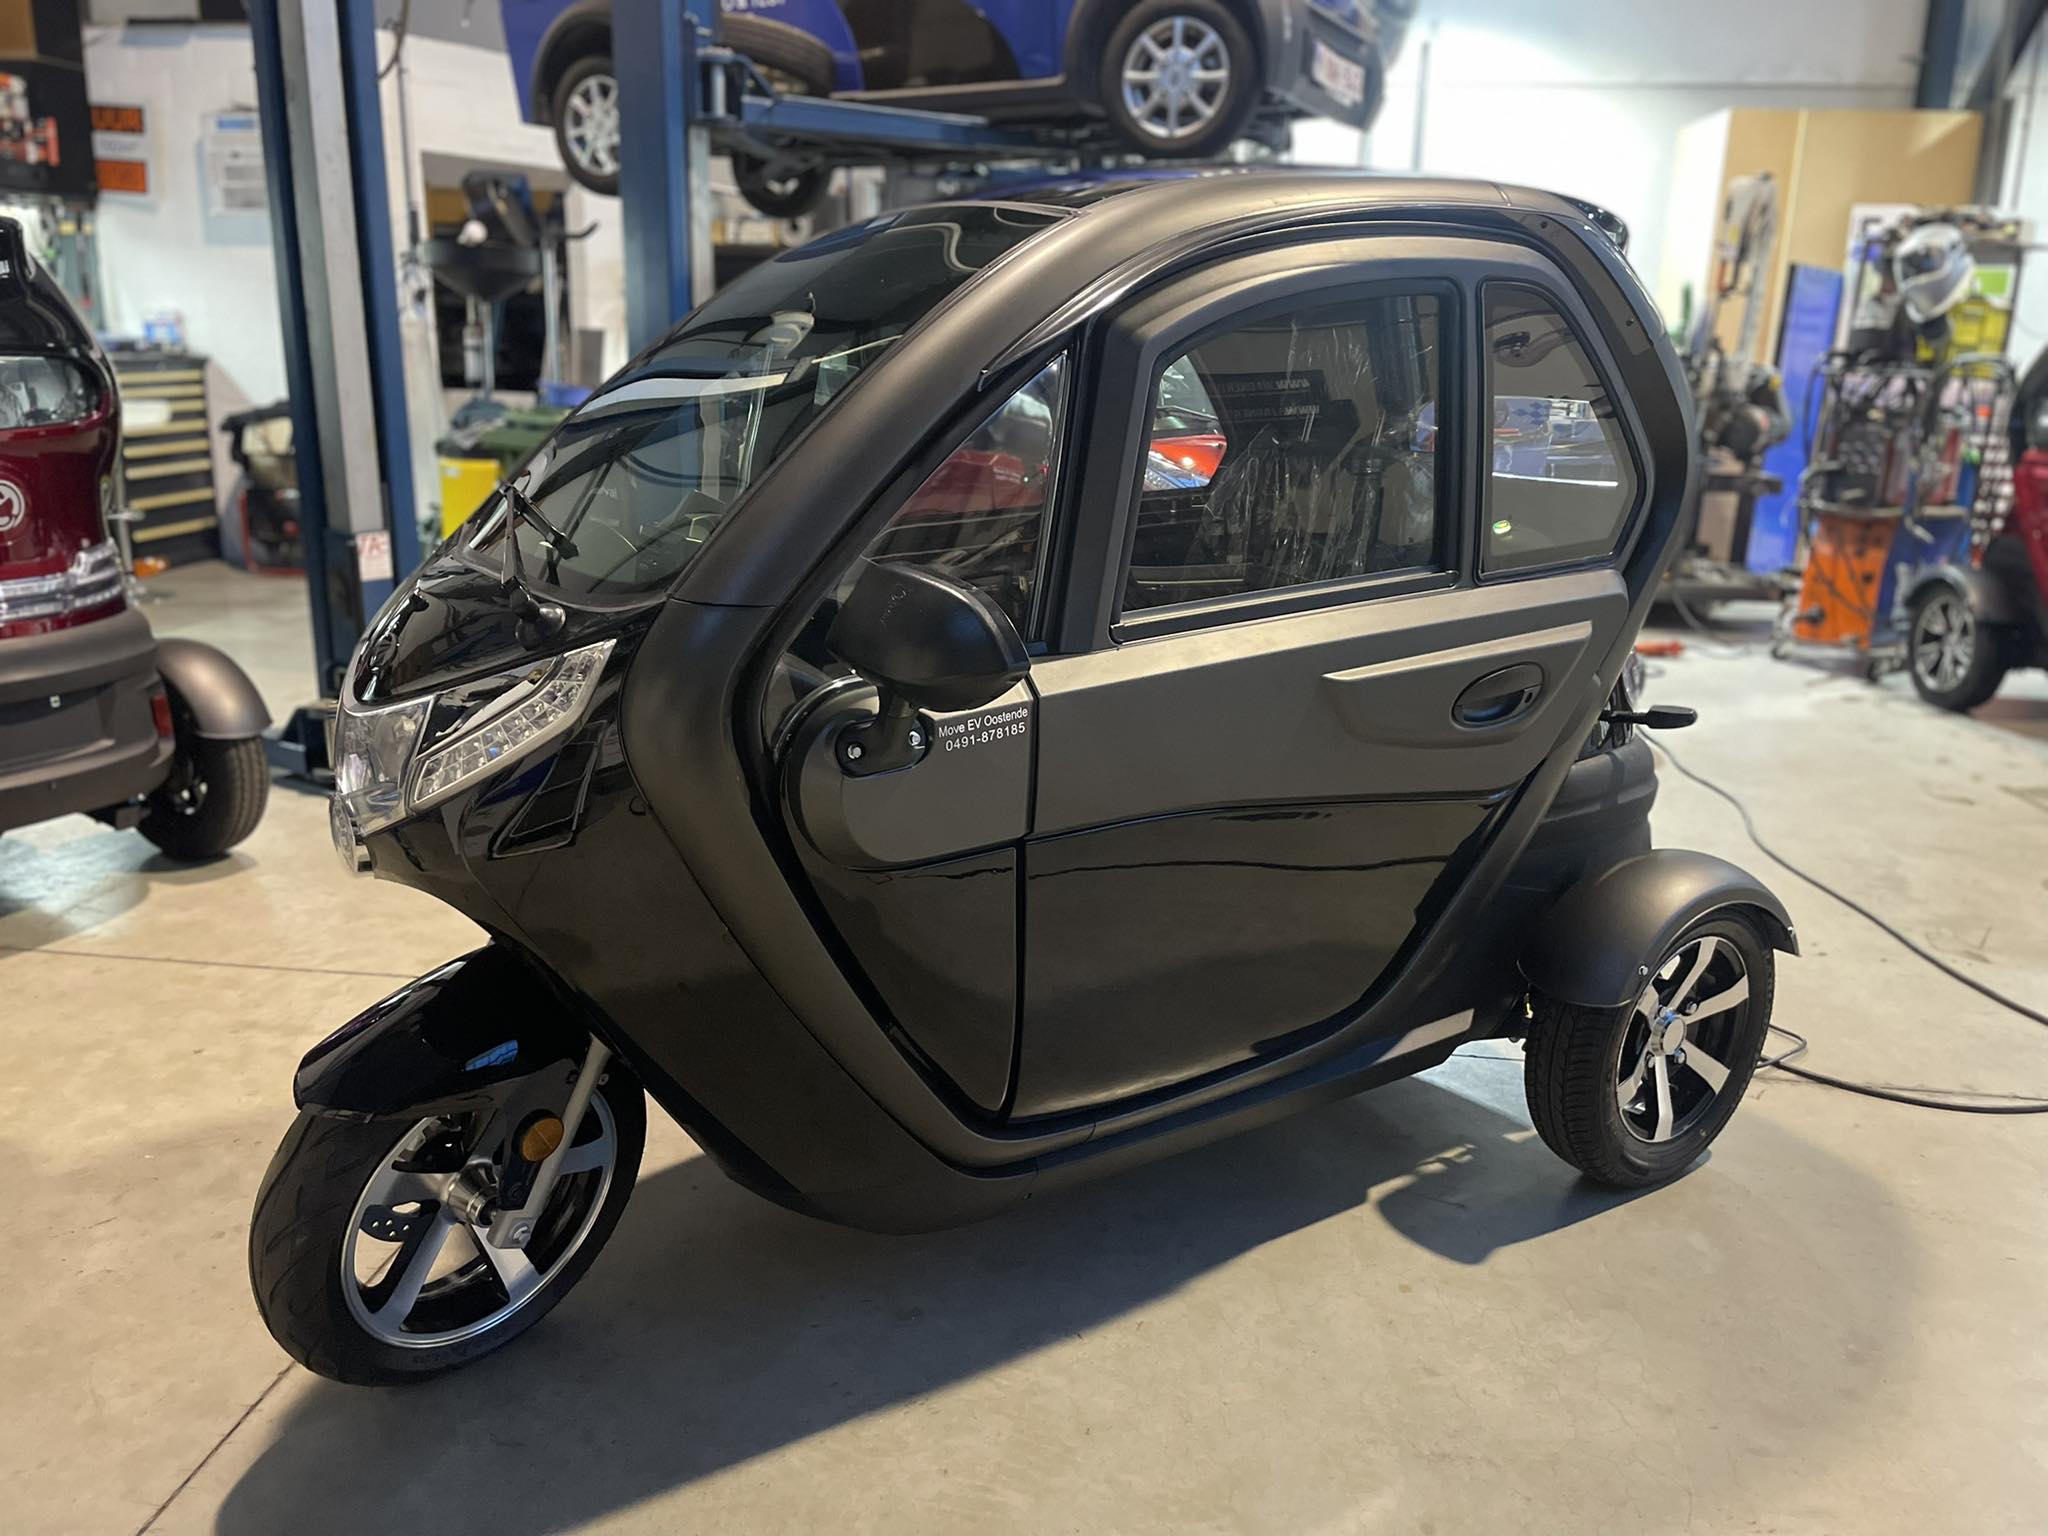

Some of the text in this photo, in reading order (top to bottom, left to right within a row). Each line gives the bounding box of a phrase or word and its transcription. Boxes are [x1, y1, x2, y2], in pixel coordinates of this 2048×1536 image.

[938, 707, 1028, 738] Move EV Oostende
[945, 721, 1026, 751] 0491-878185
